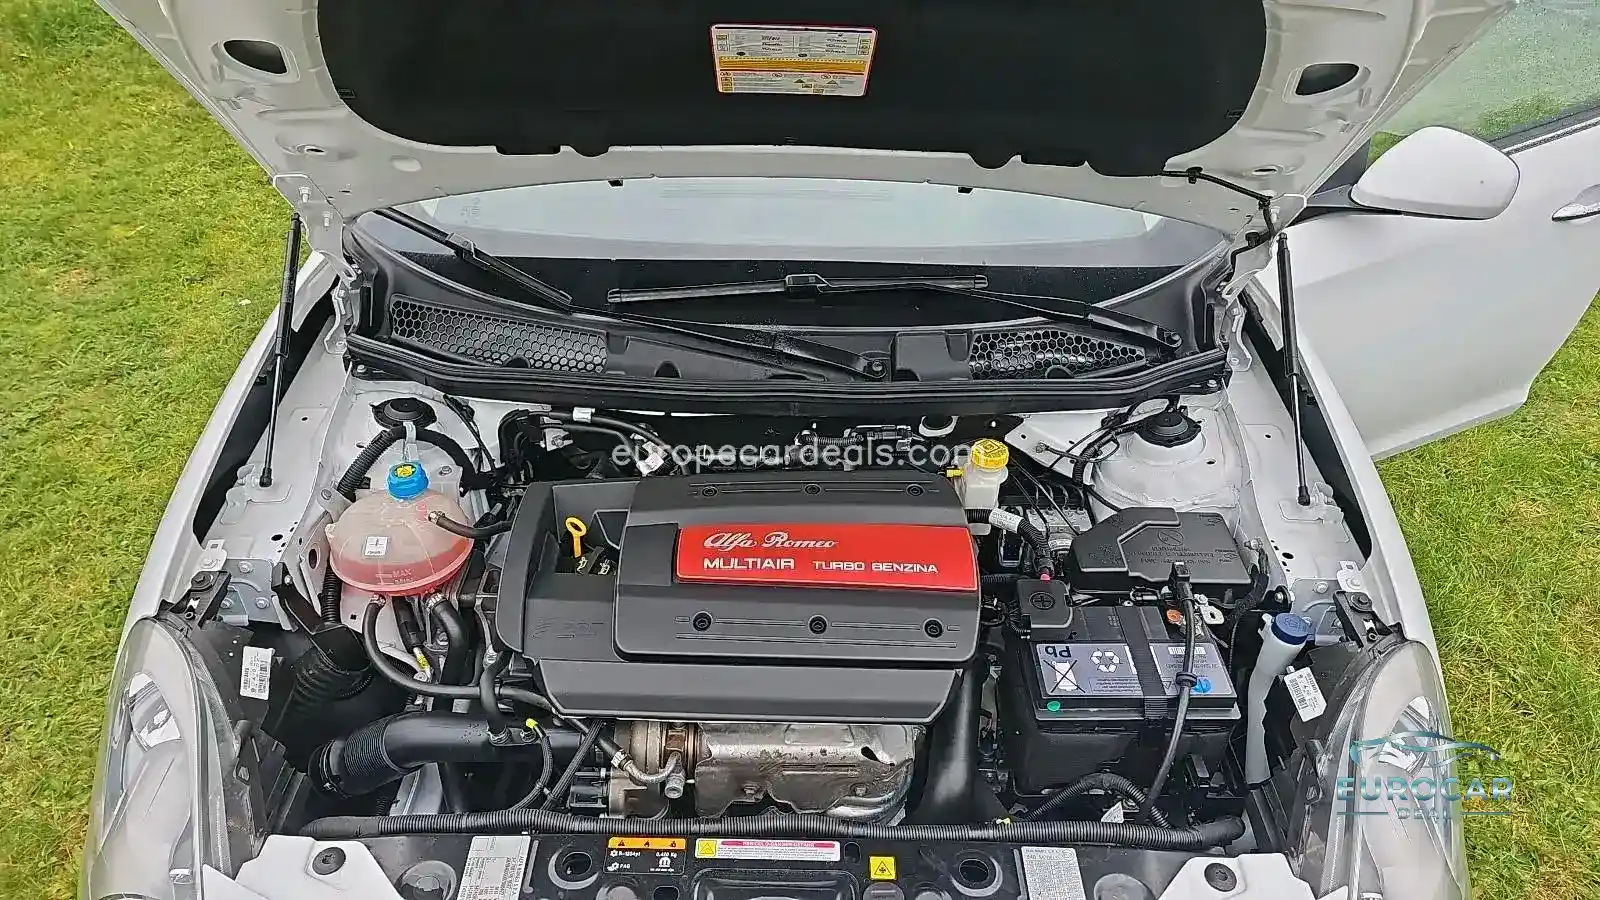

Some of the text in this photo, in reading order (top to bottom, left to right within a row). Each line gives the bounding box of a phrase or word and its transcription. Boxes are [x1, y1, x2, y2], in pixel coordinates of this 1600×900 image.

[703, 531, 839, 552] Alfa Romeo
[703, 557, 795, 570] MULTIAIR
[812, 560, 939, 573] TURBO BENZINA
